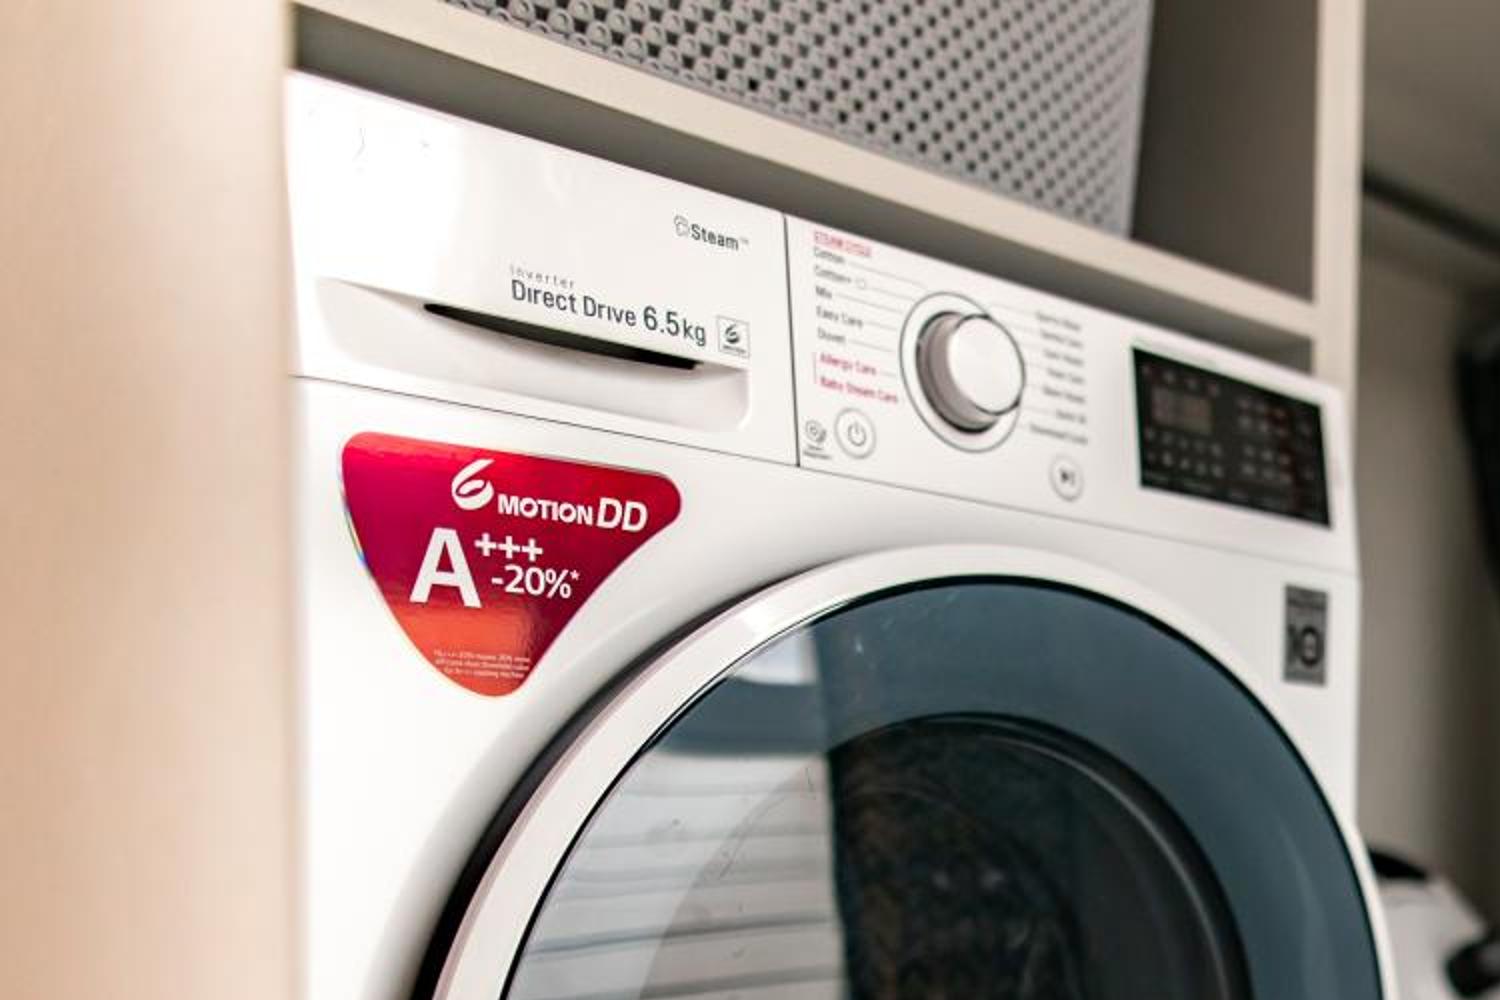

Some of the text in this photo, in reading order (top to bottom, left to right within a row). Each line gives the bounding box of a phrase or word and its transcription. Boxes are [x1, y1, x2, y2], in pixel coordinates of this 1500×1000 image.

[509, 264, 575, 289] Inverter
[511, 279, 577, 315] Direct
[583, 295, 637, 327] Drive
[842, 312, 863, 328] Care
[855, 360, 877, 376] Care
[498, 493, 593, 526] MOTION
[596, 497, 648, 533] DD
